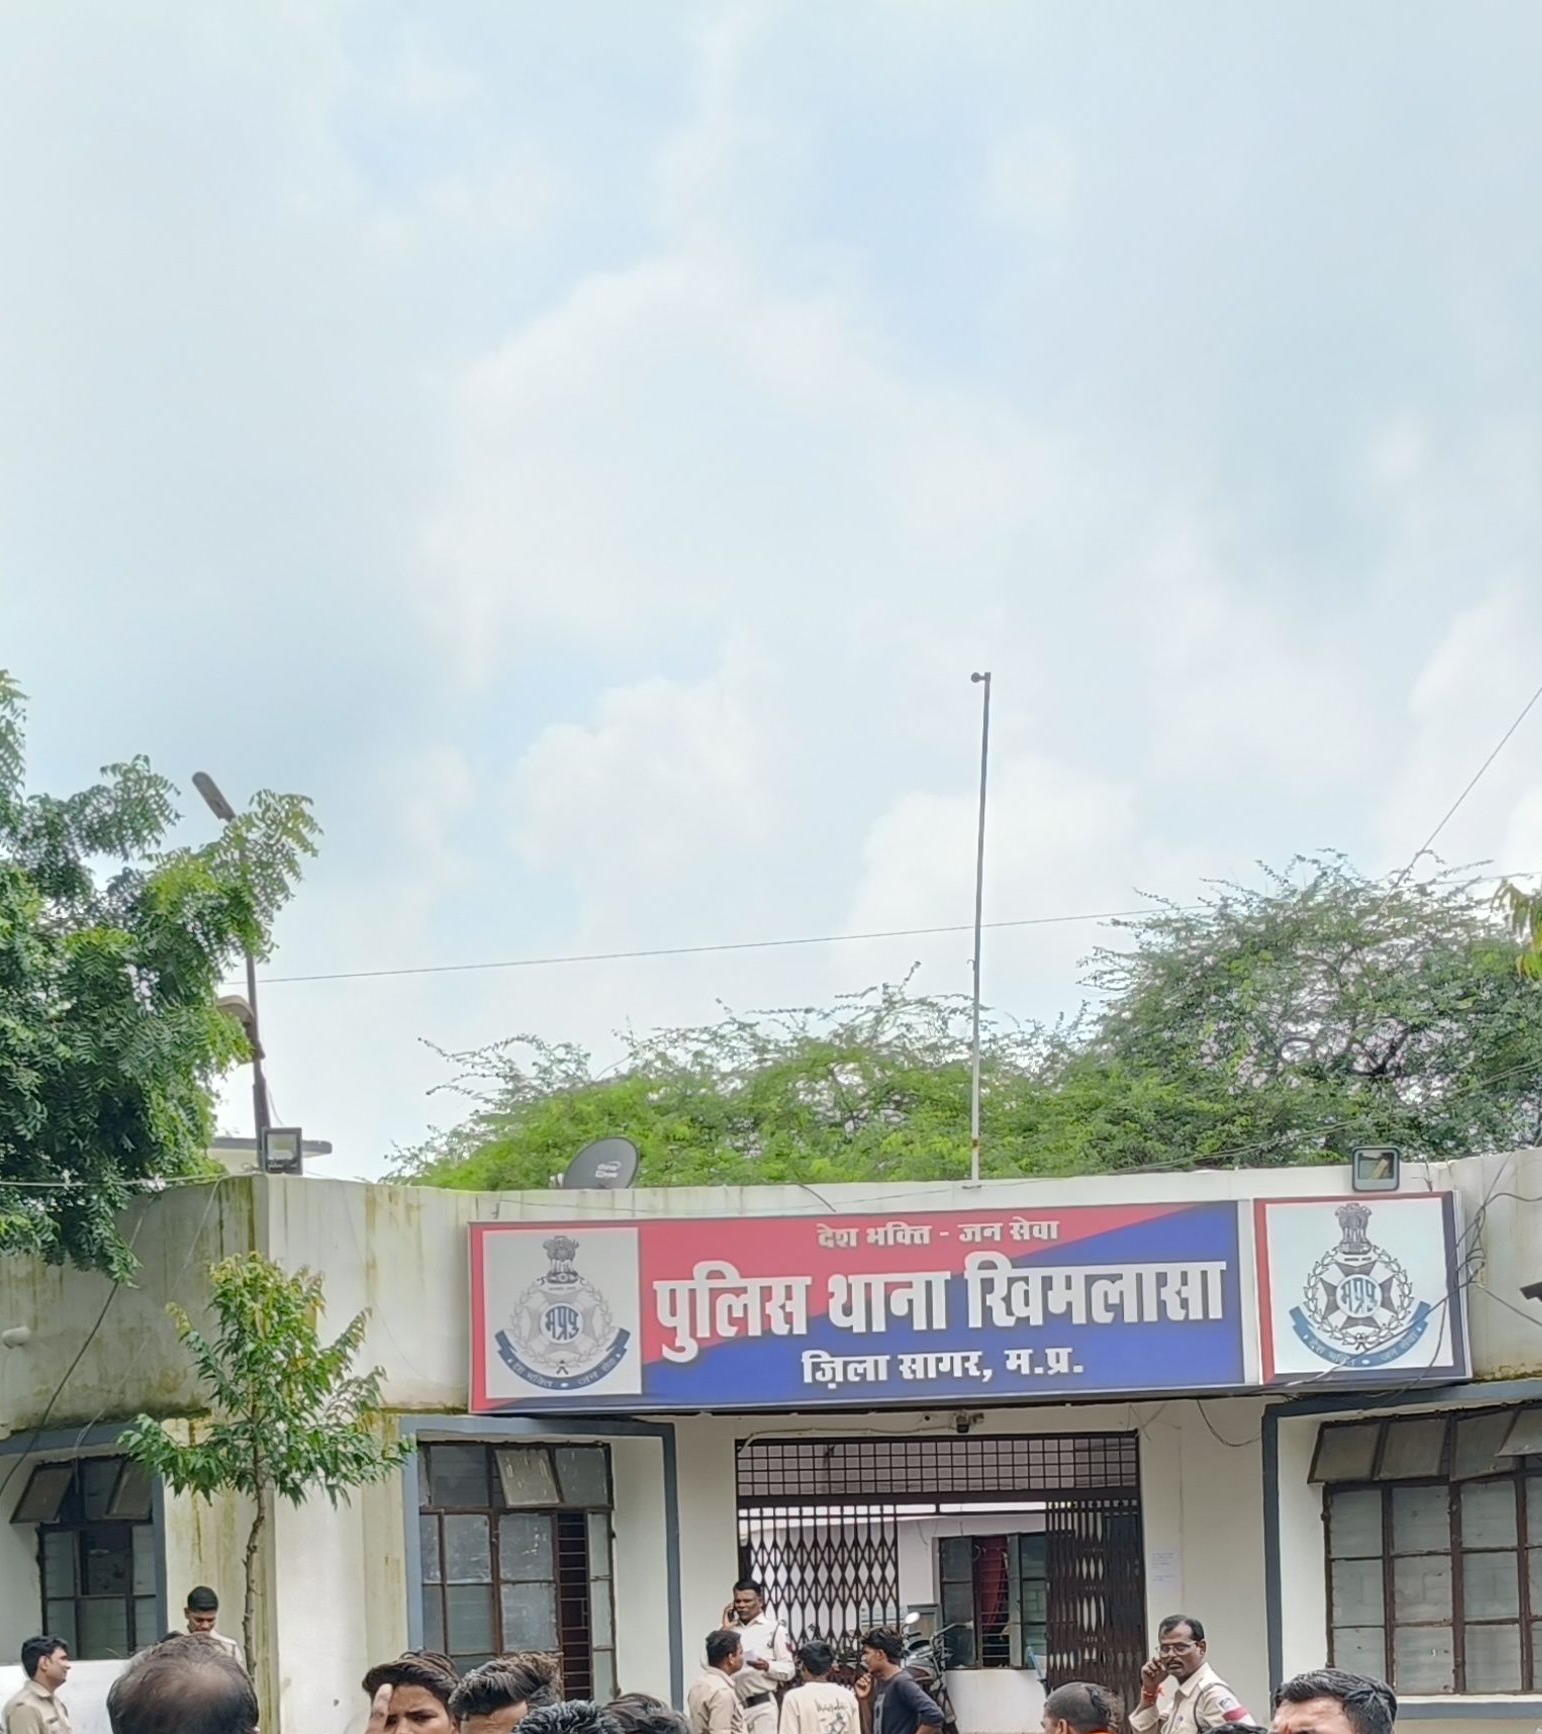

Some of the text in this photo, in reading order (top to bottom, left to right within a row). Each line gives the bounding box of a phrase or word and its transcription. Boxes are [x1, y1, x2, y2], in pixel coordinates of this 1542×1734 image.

[817, 1224, 858, 1249] देश
[865, 1221, 933, 1246] भक्ति
[958, 1222, 1003, 1244] जन
[1009, 1216, 1061, 1241] सेवा
[652, 1251, 1228, 1363] पुलिस थाना खिमलासा
[898, 1349, 992, 1382] सागर,
[1004, 1347, 1084, 1376] म.प्र.
